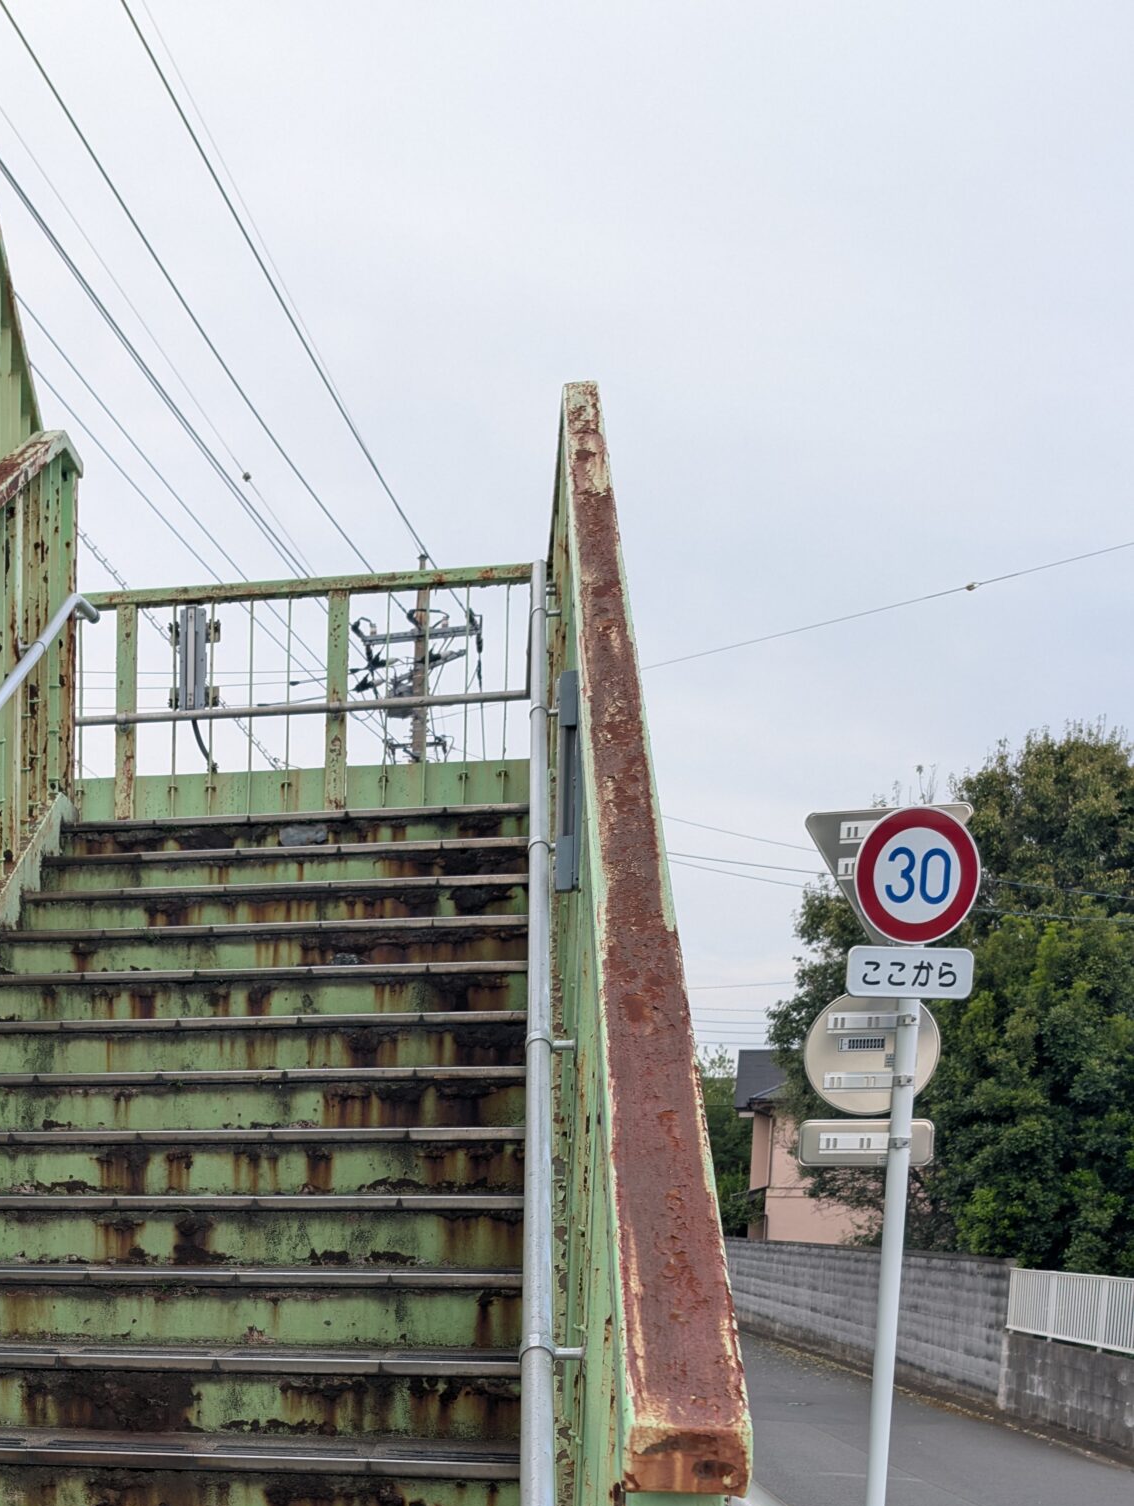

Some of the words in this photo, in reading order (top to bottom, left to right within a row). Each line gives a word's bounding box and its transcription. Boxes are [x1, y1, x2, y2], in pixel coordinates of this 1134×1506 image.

[885, 847, 951, 905] 30
[862, 960, 957, 987] ここから
